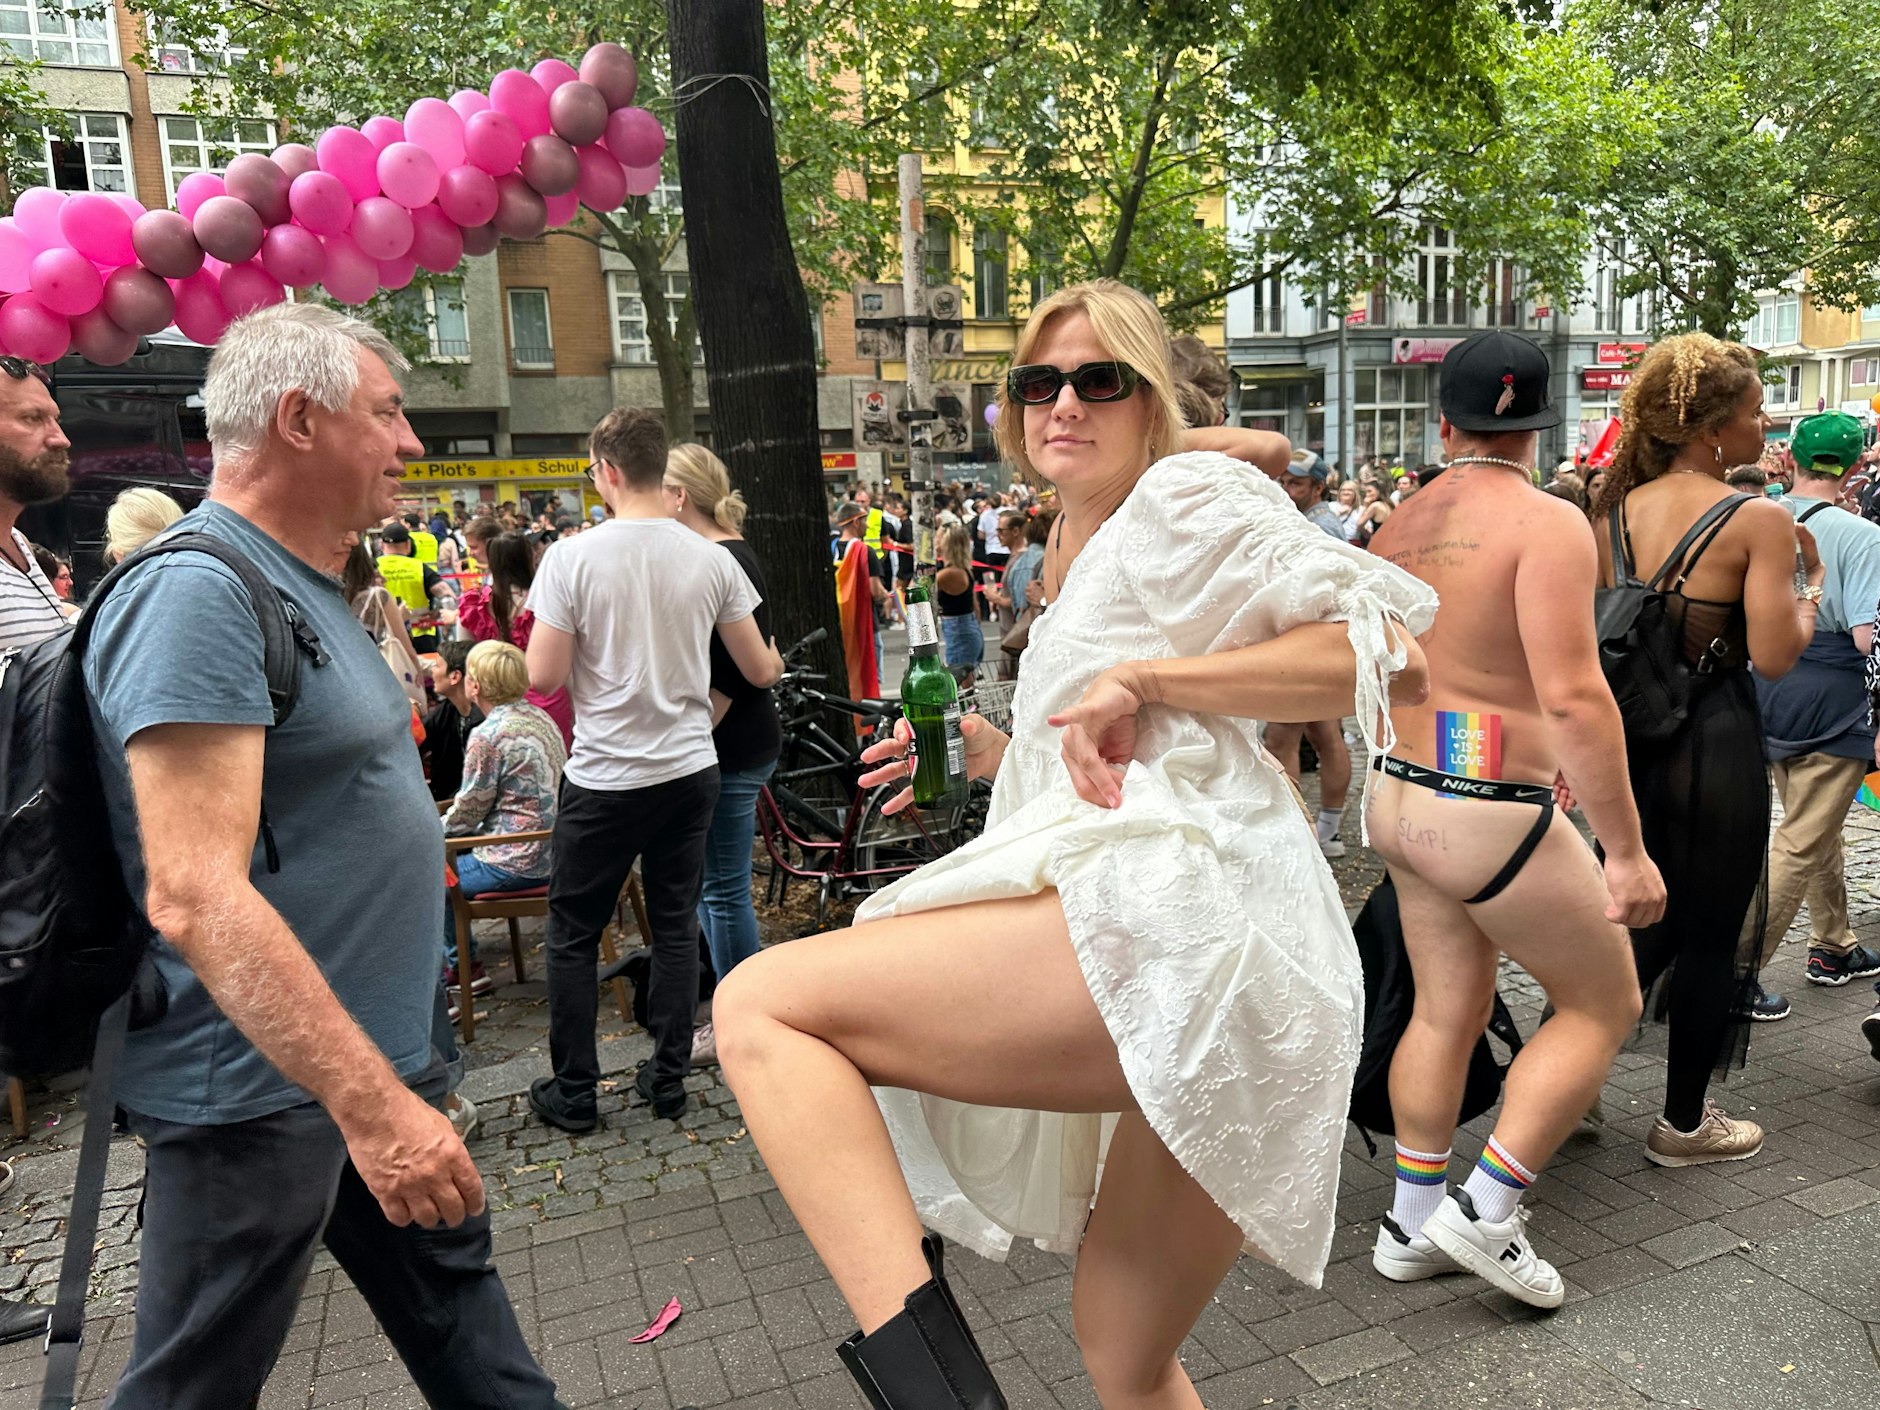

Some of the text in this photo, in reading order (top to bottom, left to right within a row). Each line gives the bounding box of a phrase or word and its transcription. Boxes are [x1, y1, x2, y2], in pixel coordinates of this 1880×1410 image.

[429, 463, 476, 477] Plot's
[538, 461, 579, 474] Schul
[1450, 728, 1485, 740] LOVE
[1461, 743, 1473, 752] IS
[1450, 754, 1485, 766] LOVE
[1442, 778, 1499, 795] NIKE
[1398, 817, 1447, 850] SLAP!
